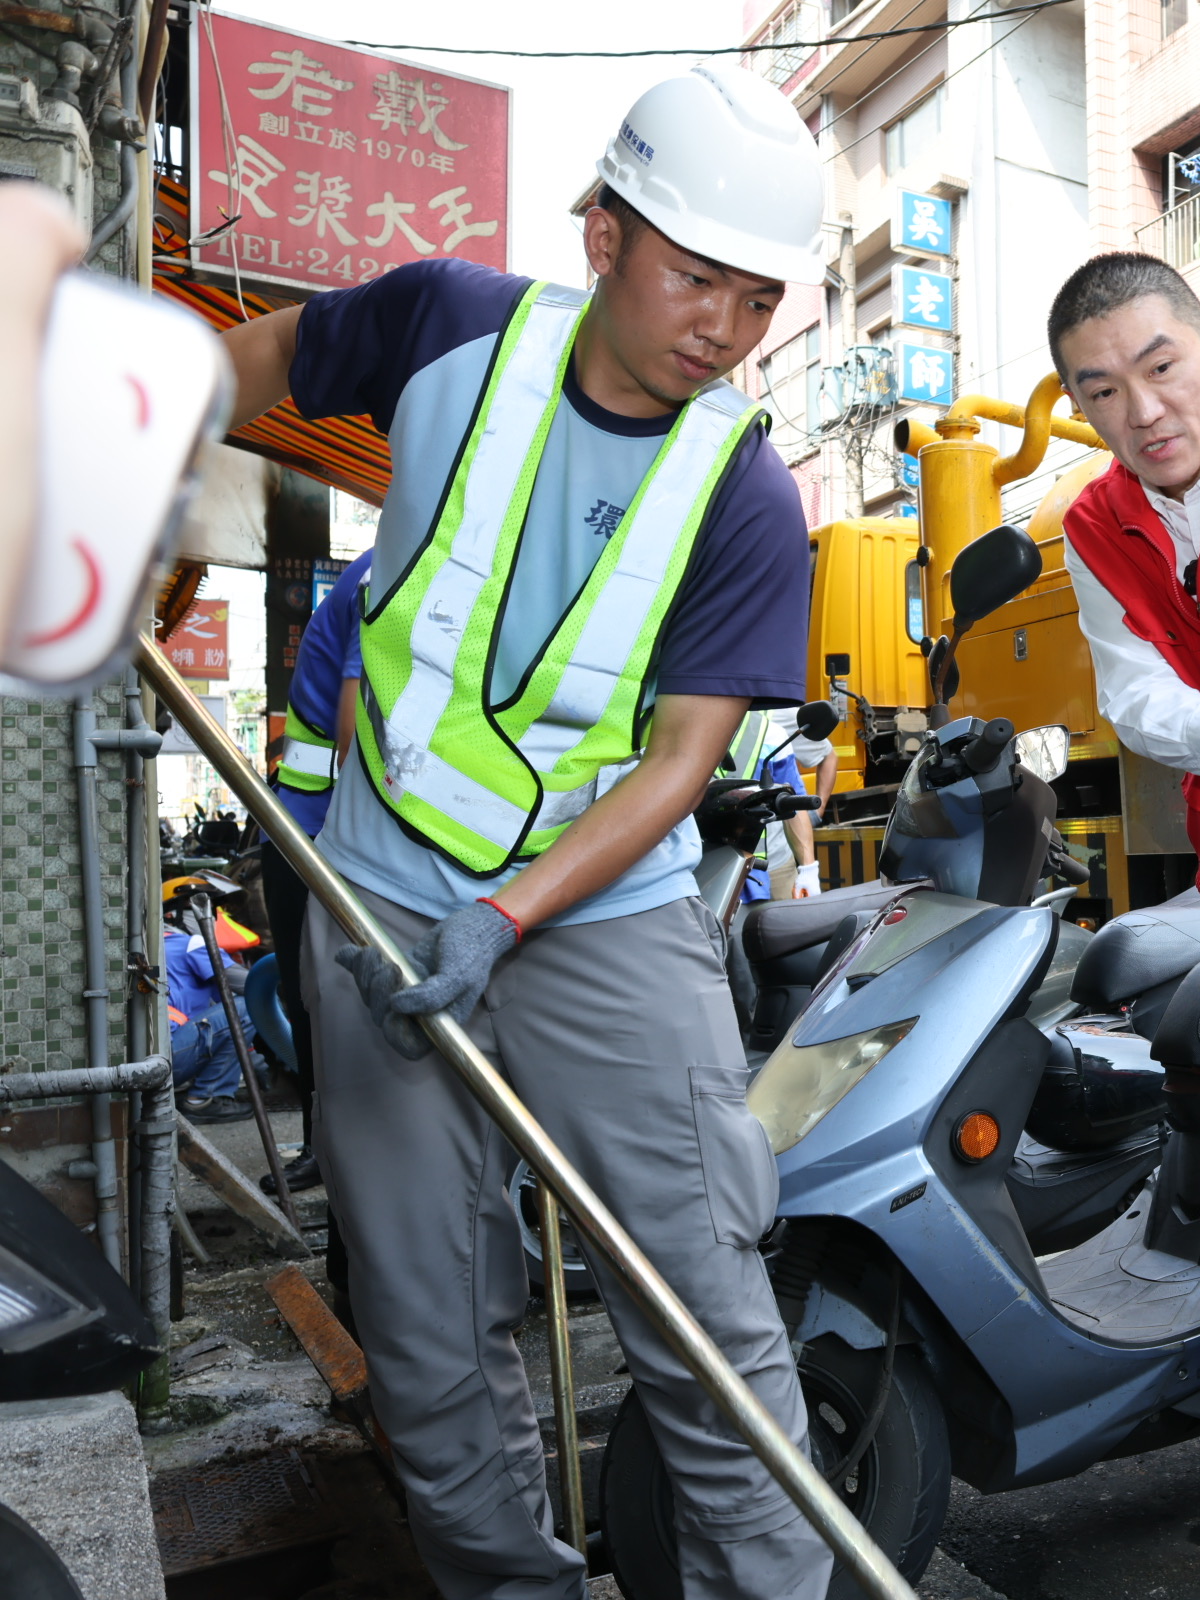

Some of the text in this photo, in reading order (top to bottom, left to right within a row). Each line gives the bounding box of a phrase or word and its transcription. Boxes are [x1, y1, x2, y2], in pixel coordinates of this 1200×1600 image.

[258, 111, 455, 174] 創立於1970年
[208, 134, 498, 255] 豆漿大王
